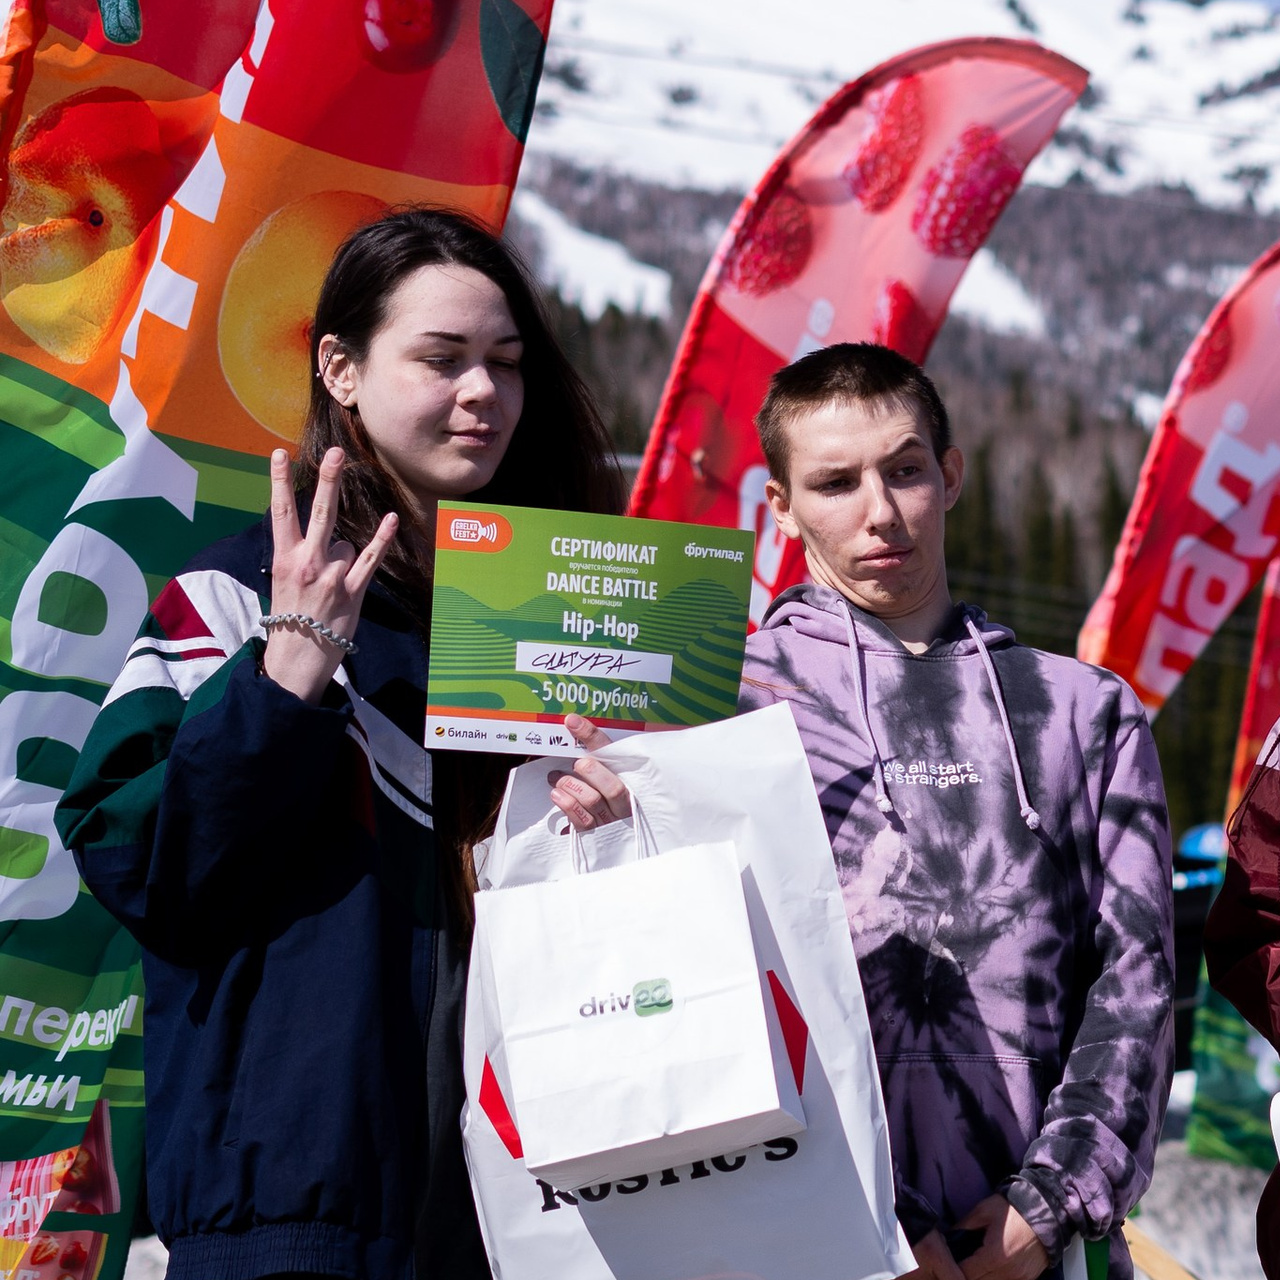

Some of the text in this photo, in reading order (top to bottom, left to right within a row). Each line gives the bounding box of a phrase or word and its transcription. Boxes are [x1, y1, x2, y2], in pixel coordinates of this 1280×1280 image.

[550, 536, 658, 565] СЕРТИФИКАТ
[684, 542, 743, 562] фрутилад
[569, 562, 639, 575] вручается победителю
[547, 572, 658, 601] DANCE BATTLE
[587, 597, 623, 608] номинации
[562, 610, 639, 645] Hip-Hop
[542, 681, 648, 712] 5 000 рублей
[448, 728, 487, 740] билайн
[883, 760, 975, 775] we all start
[896, 773, 983, 789] strangers.
